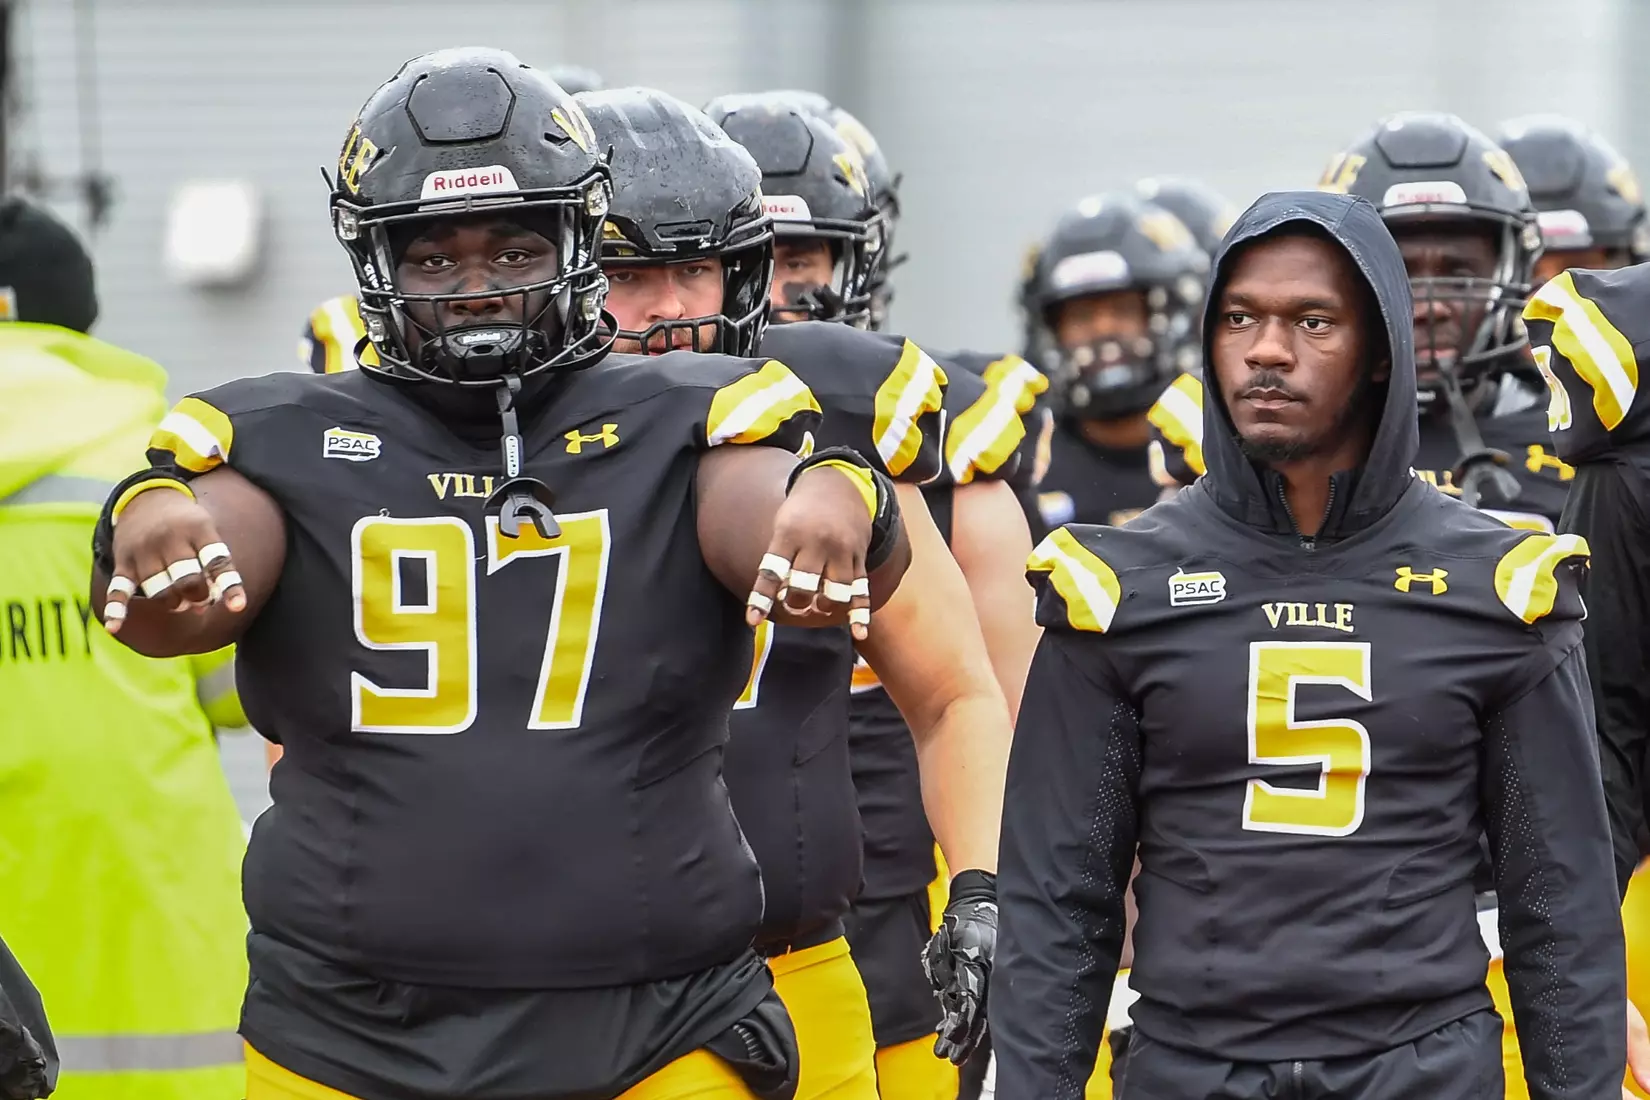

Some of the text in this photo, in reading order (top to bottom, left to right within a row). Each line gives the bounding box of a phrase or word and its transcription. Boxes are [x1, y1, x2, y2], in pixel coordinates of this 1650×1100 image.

[433, 172, 503, 190] Riddell
[327, 436, 376, 451] PSAC
[427, 473, 496, 500] VILL
[1173, 580, 1221, 596] PSAC
[0, 599, 91, 660] RITY
[351, 509, 612, 734] 97
[1261, 602, 1354, 632] VILLE
[1242, 641, 1372, 837] 5
